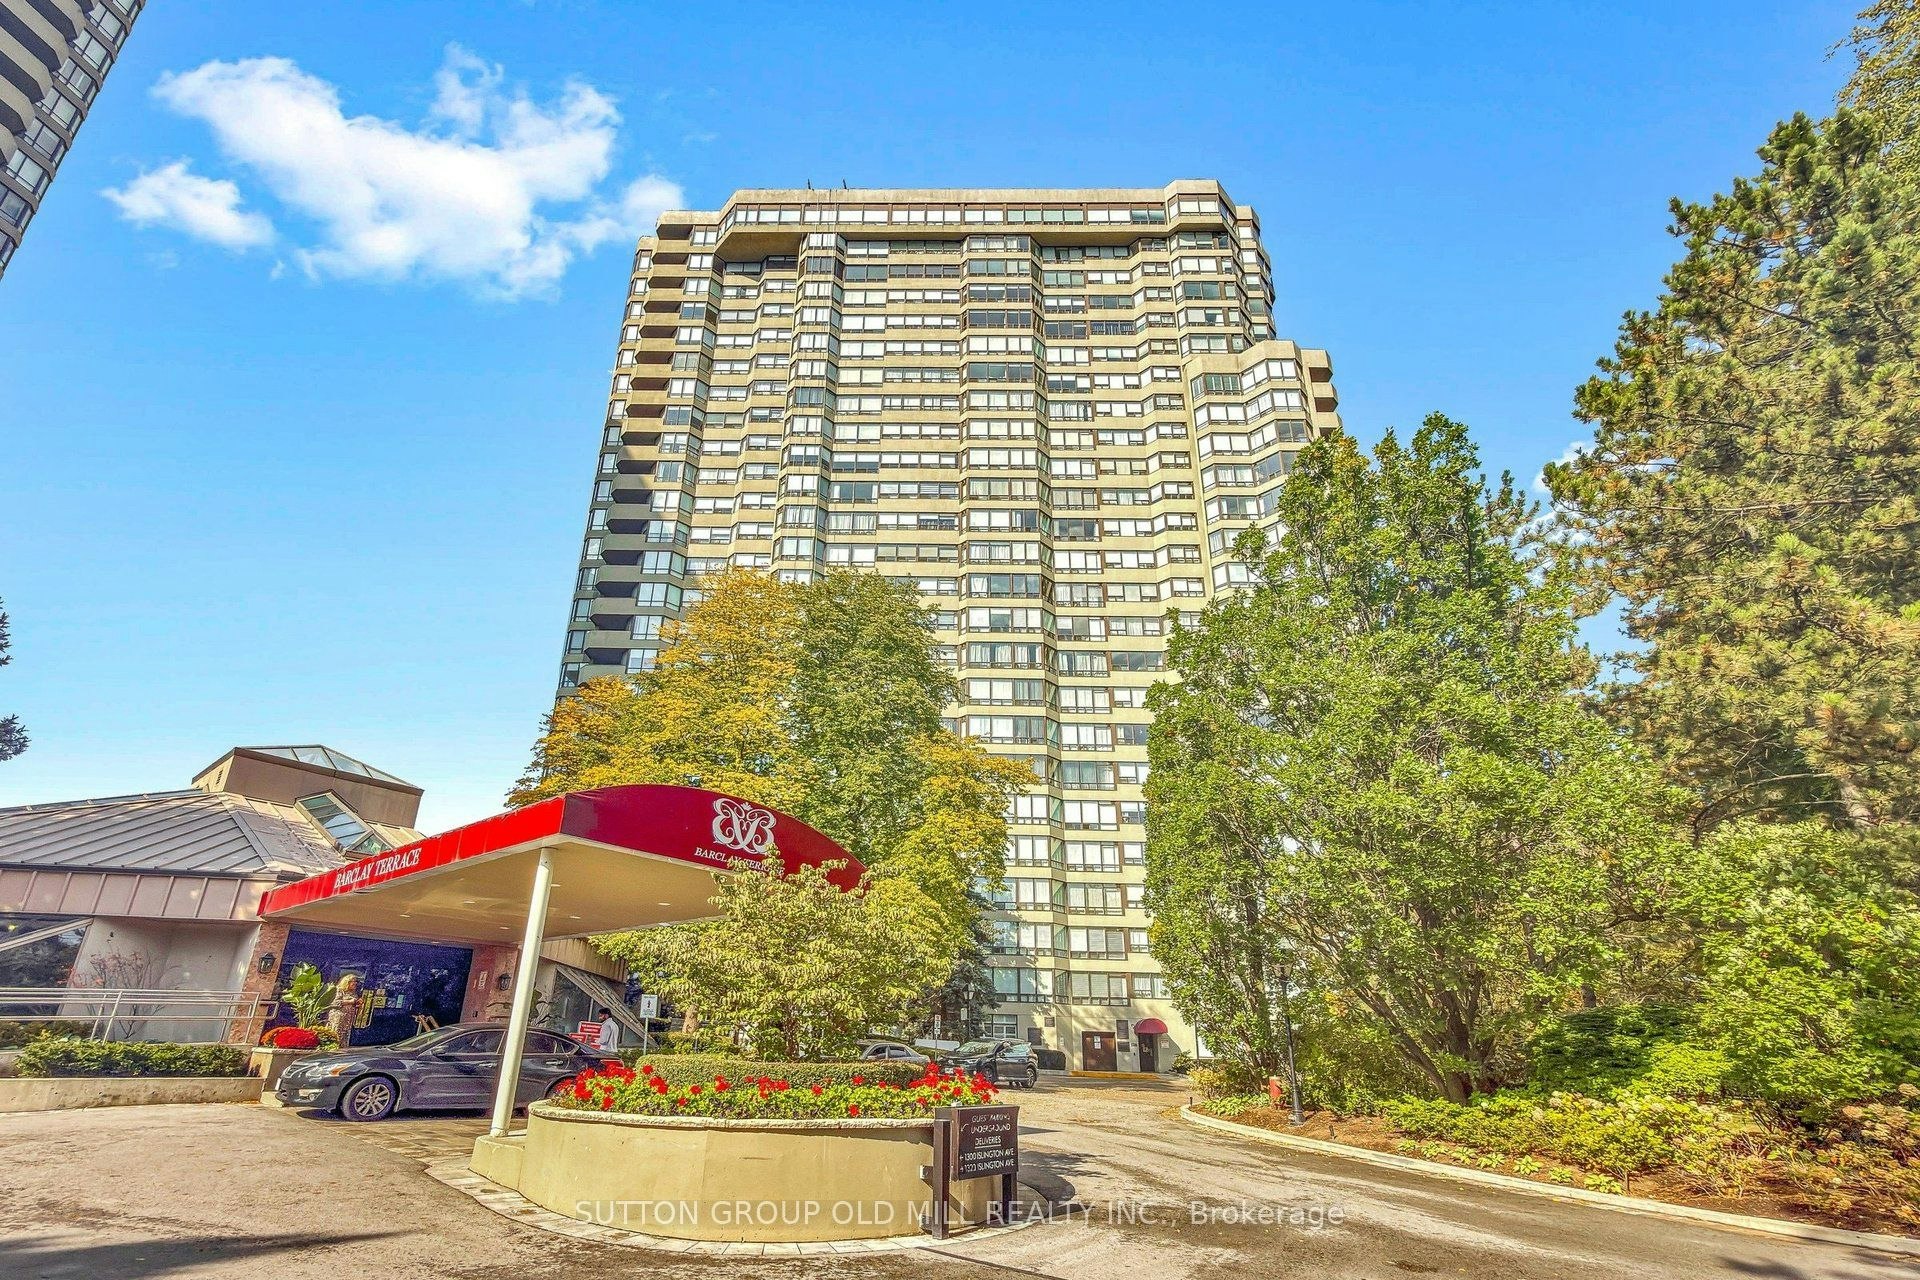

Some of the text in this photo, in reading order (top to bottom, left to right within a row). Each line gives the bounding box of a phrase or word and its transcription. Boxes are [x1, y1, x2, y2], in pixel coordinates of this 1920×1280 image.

[334, 848, 422, 888] BARCLAY TERRACE
[743, 858, 786, 877] TERRE
[970, 1123, 1011, 1134] UNDERGROUND
[975, 1136, 1001, 1145] DELIVERIES
[964, 1147, 1014, 1161] 1300 ISLINGTON AVE
[977, 1160, 1004, 1171] ISLINGTON
[1004, 1158, 1014, 1167] AVE
